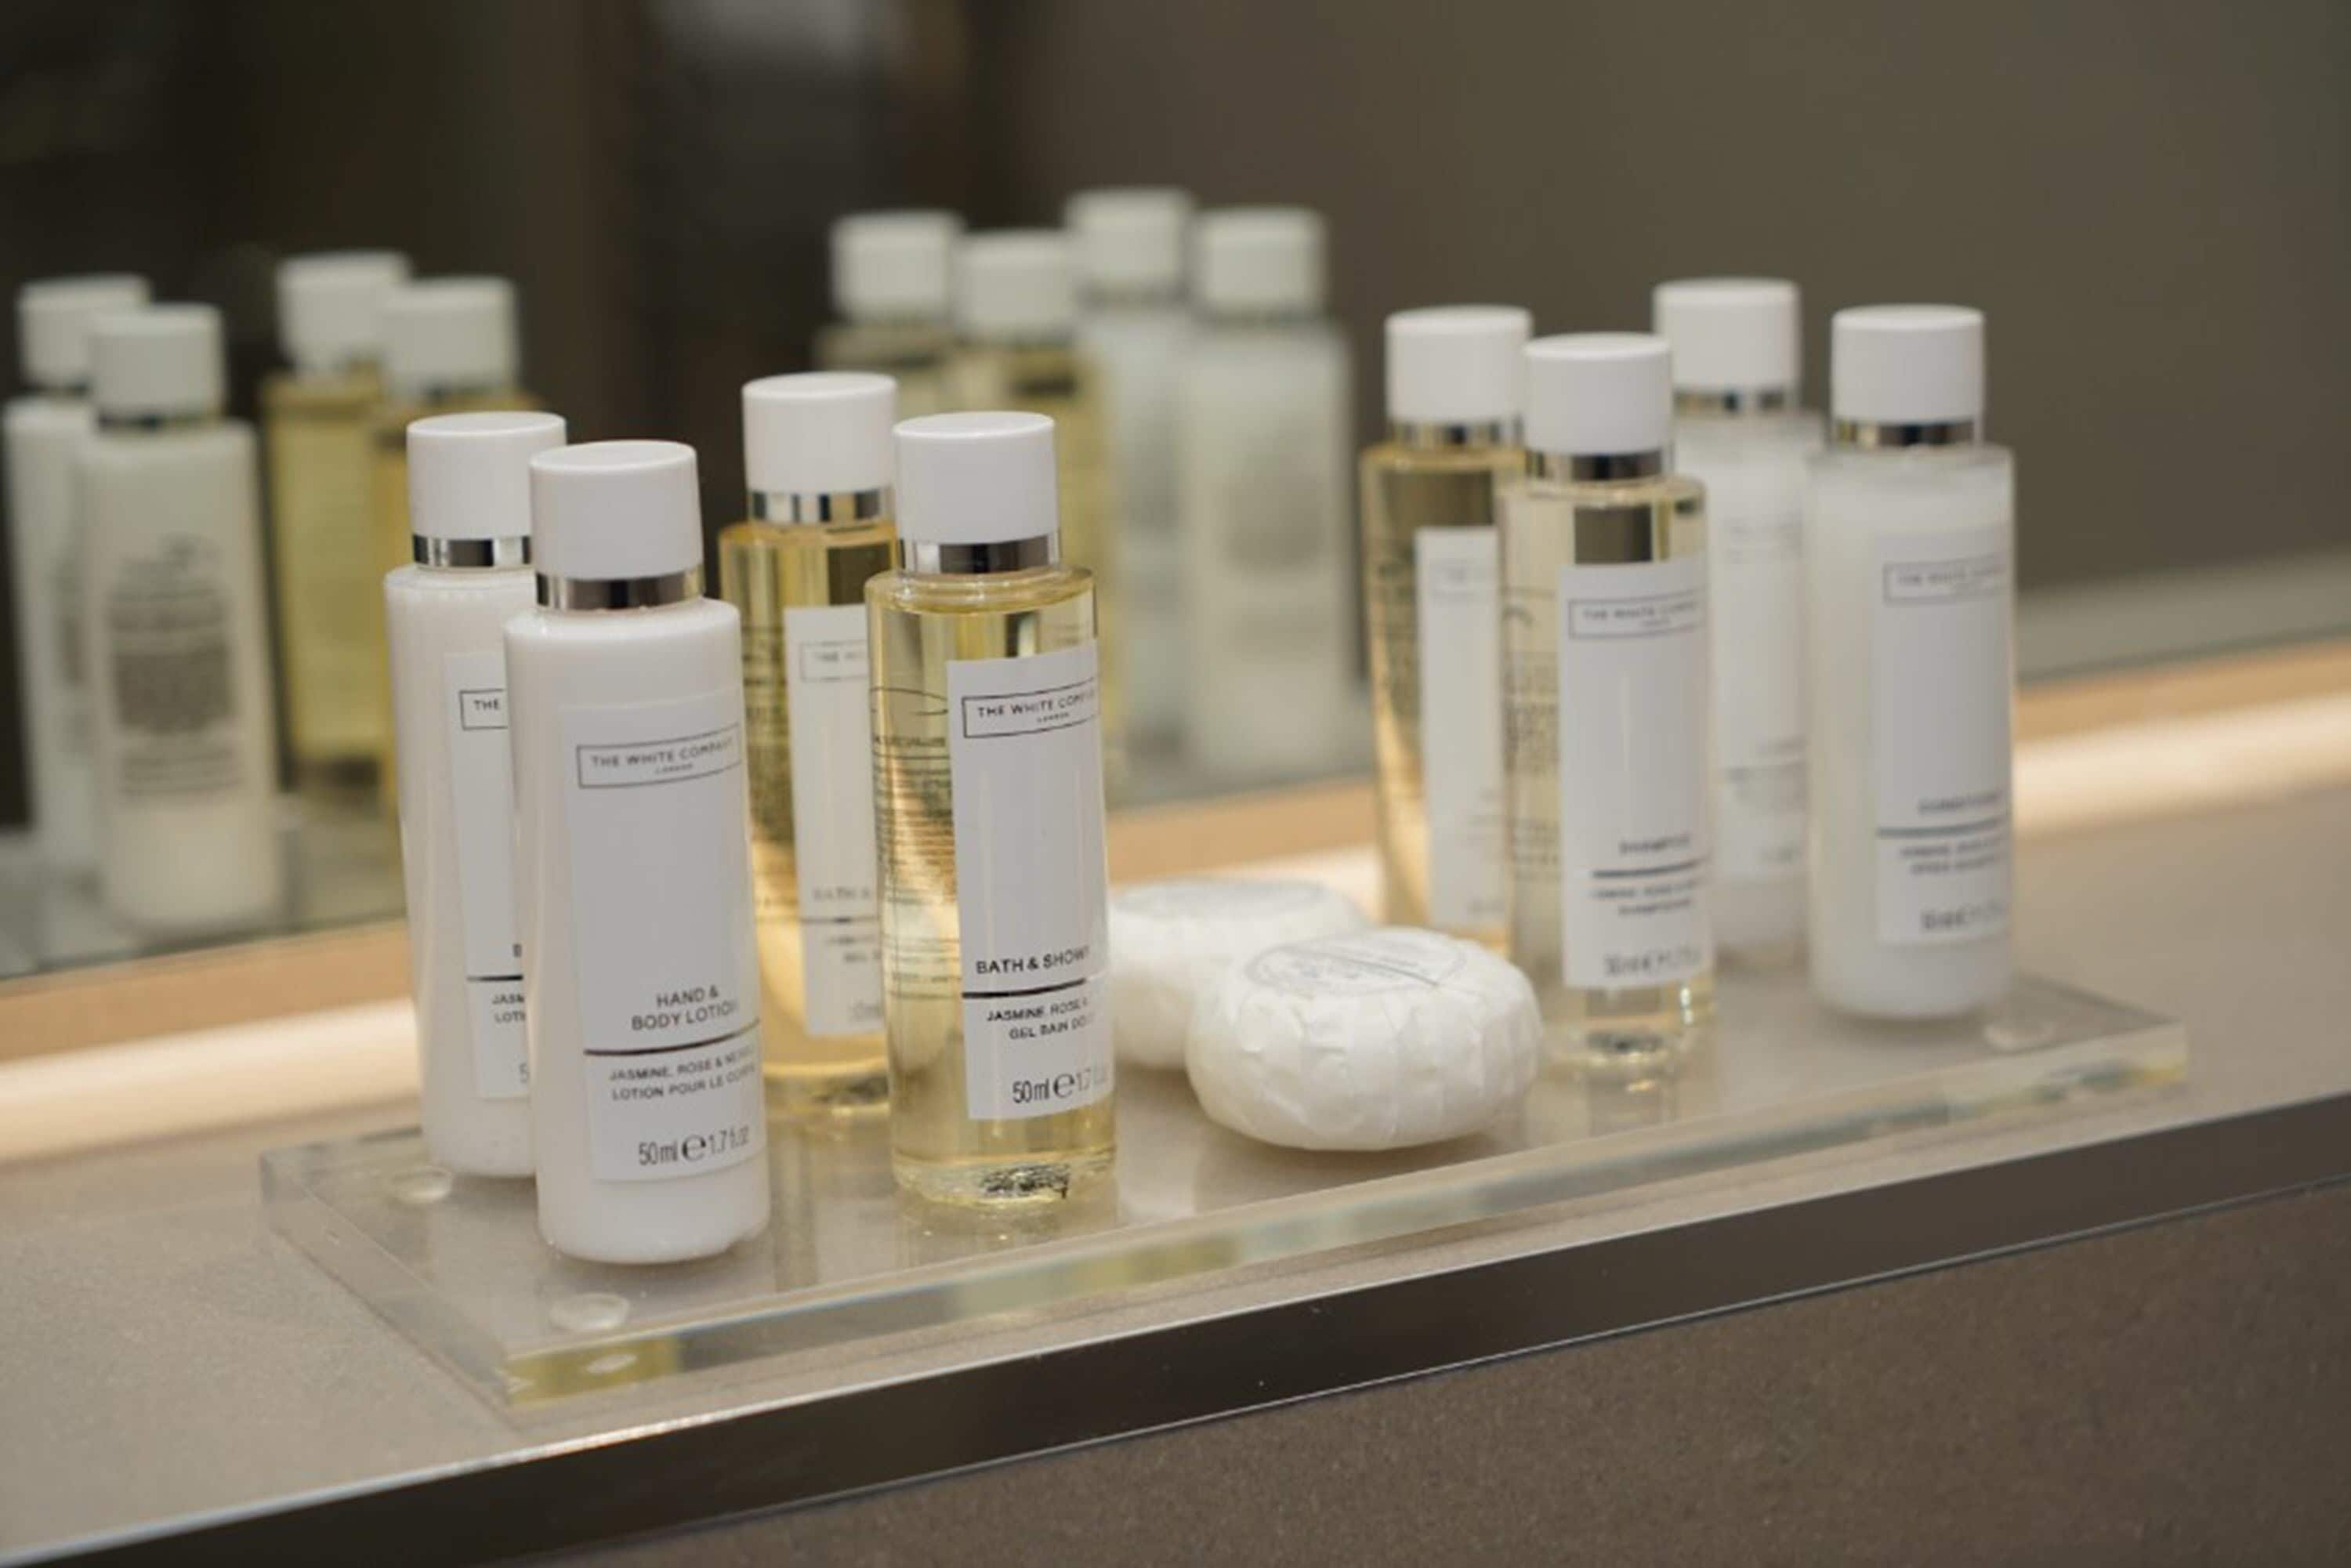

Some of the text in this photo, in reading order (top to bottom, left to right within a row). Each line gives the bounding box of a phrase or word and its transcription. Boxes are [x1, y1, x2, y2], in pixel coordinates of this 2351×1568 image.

[473, 699, 500, 711] THE
[978, 706, 1005, 718] THE
[1010, 701, 1053, 715] WHITE
[592, 755, 620, 766] THE
[627, 751, 674, 766] WHITE
[976, 958, 1024, 974] BATH
[1027, 956, 1039, 972] &
[657, 984, 719, 1008] HAND &
[632, 1013, 681, 1030] BODY
[1009, 1027, 1037, 1040] GEL
[1041, 1020, 1069, 1036] BAIN
[678, 1059, 712, 1074] ROSE
[613, 1085, 665, 1101] LOTION
[668, 1081, 706, 1095] POUR
[710, 1074, 724, 1089] LE
[1012, 1077, 1050, 1105] 50ml
